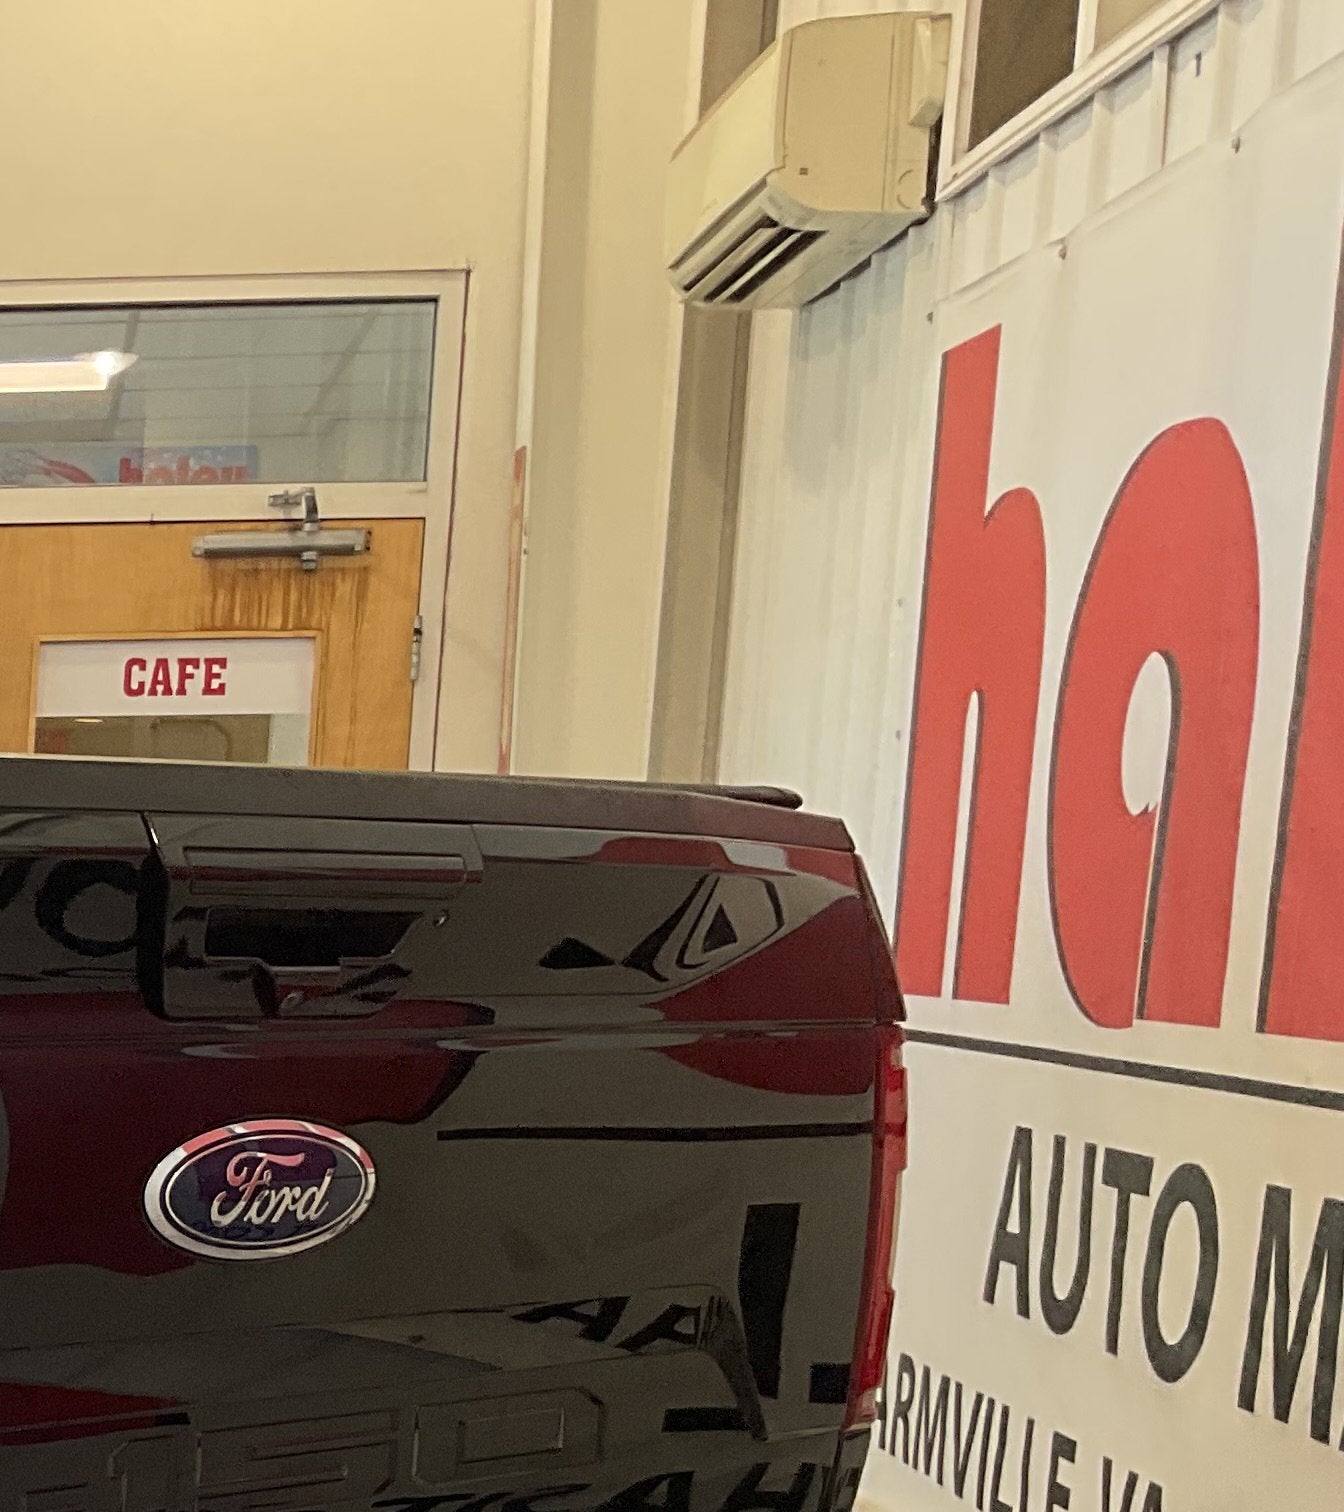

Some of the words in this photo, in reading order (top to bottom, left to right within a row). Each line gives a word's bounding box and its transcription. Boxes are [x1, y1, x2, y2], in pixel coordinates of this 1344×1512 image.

[123, 657, 228, 697] CAFE
[210, 1151, 330, 1227] Ford
[983, 1126, 1219, 1382] AUTO
[1237, 1184, 1344, 1450] M
